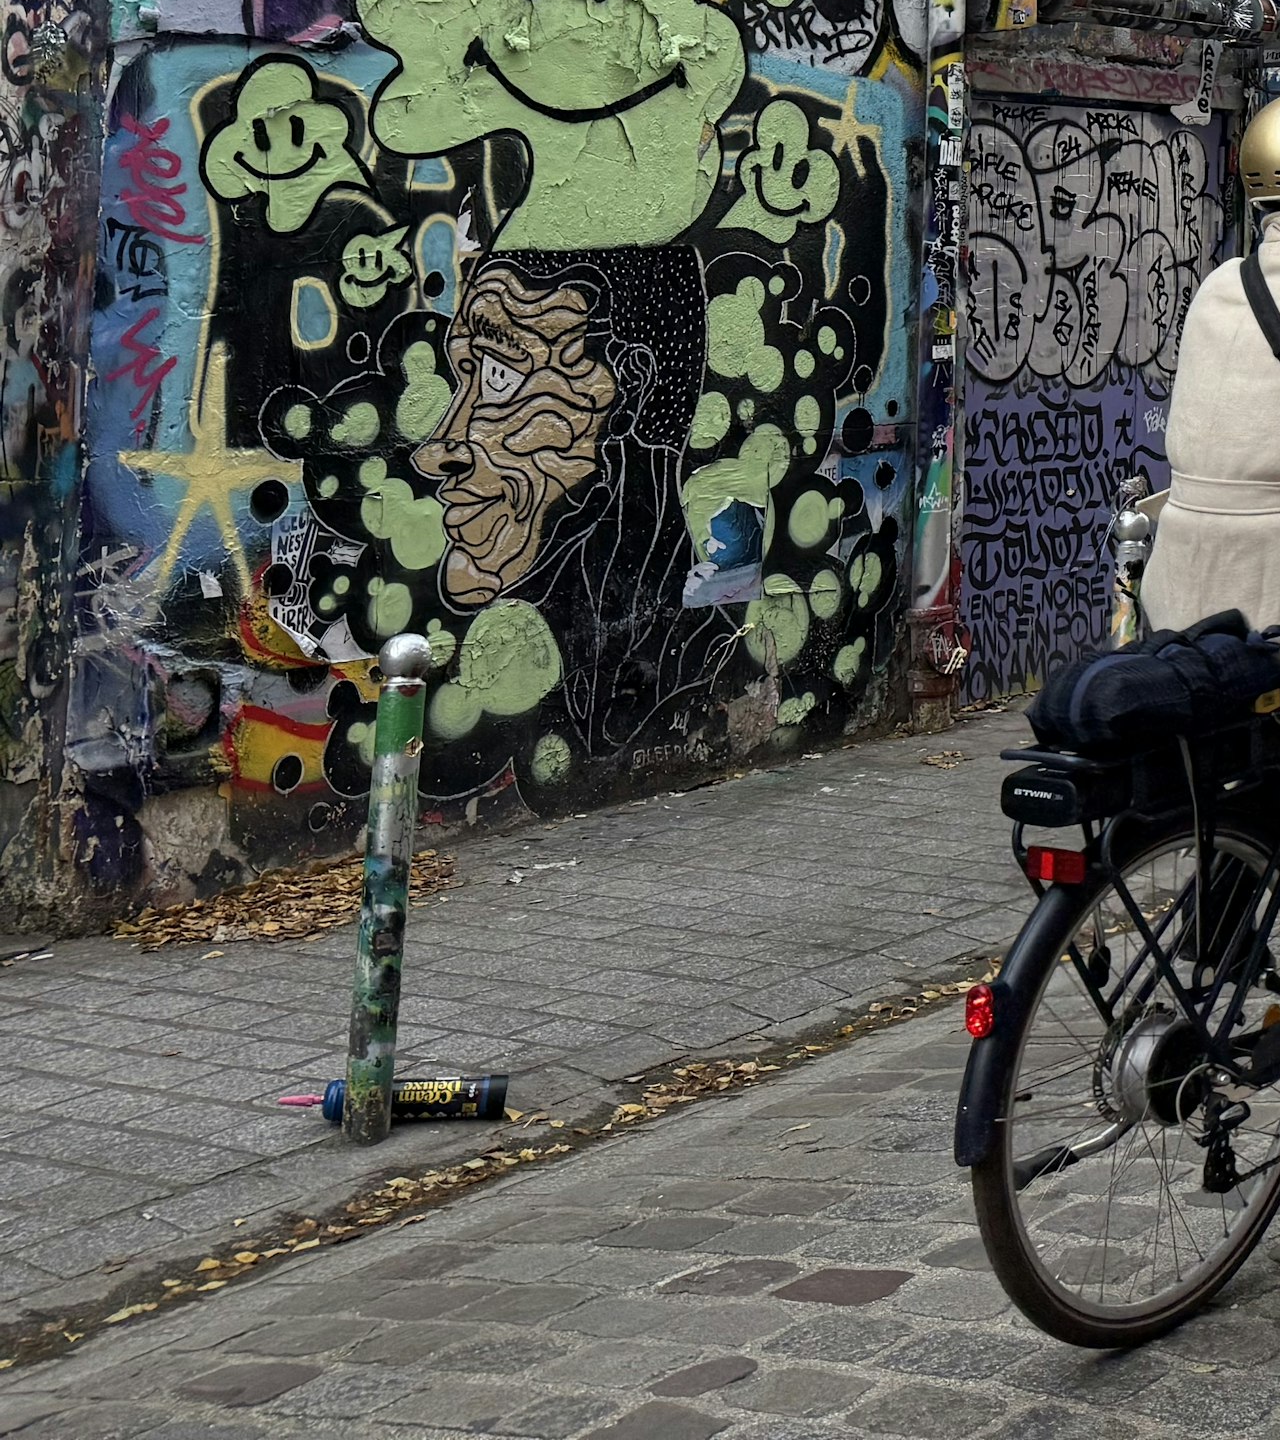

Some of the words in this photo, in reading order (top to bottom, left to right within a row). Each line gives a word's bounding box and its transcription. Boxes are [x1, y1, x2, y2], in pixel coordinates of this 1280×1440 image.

[964, 618, 1010, 661] ANS
[404, 1080, 462, 1094] Deluxe
[398, 1089, 453, 1104] Cream
